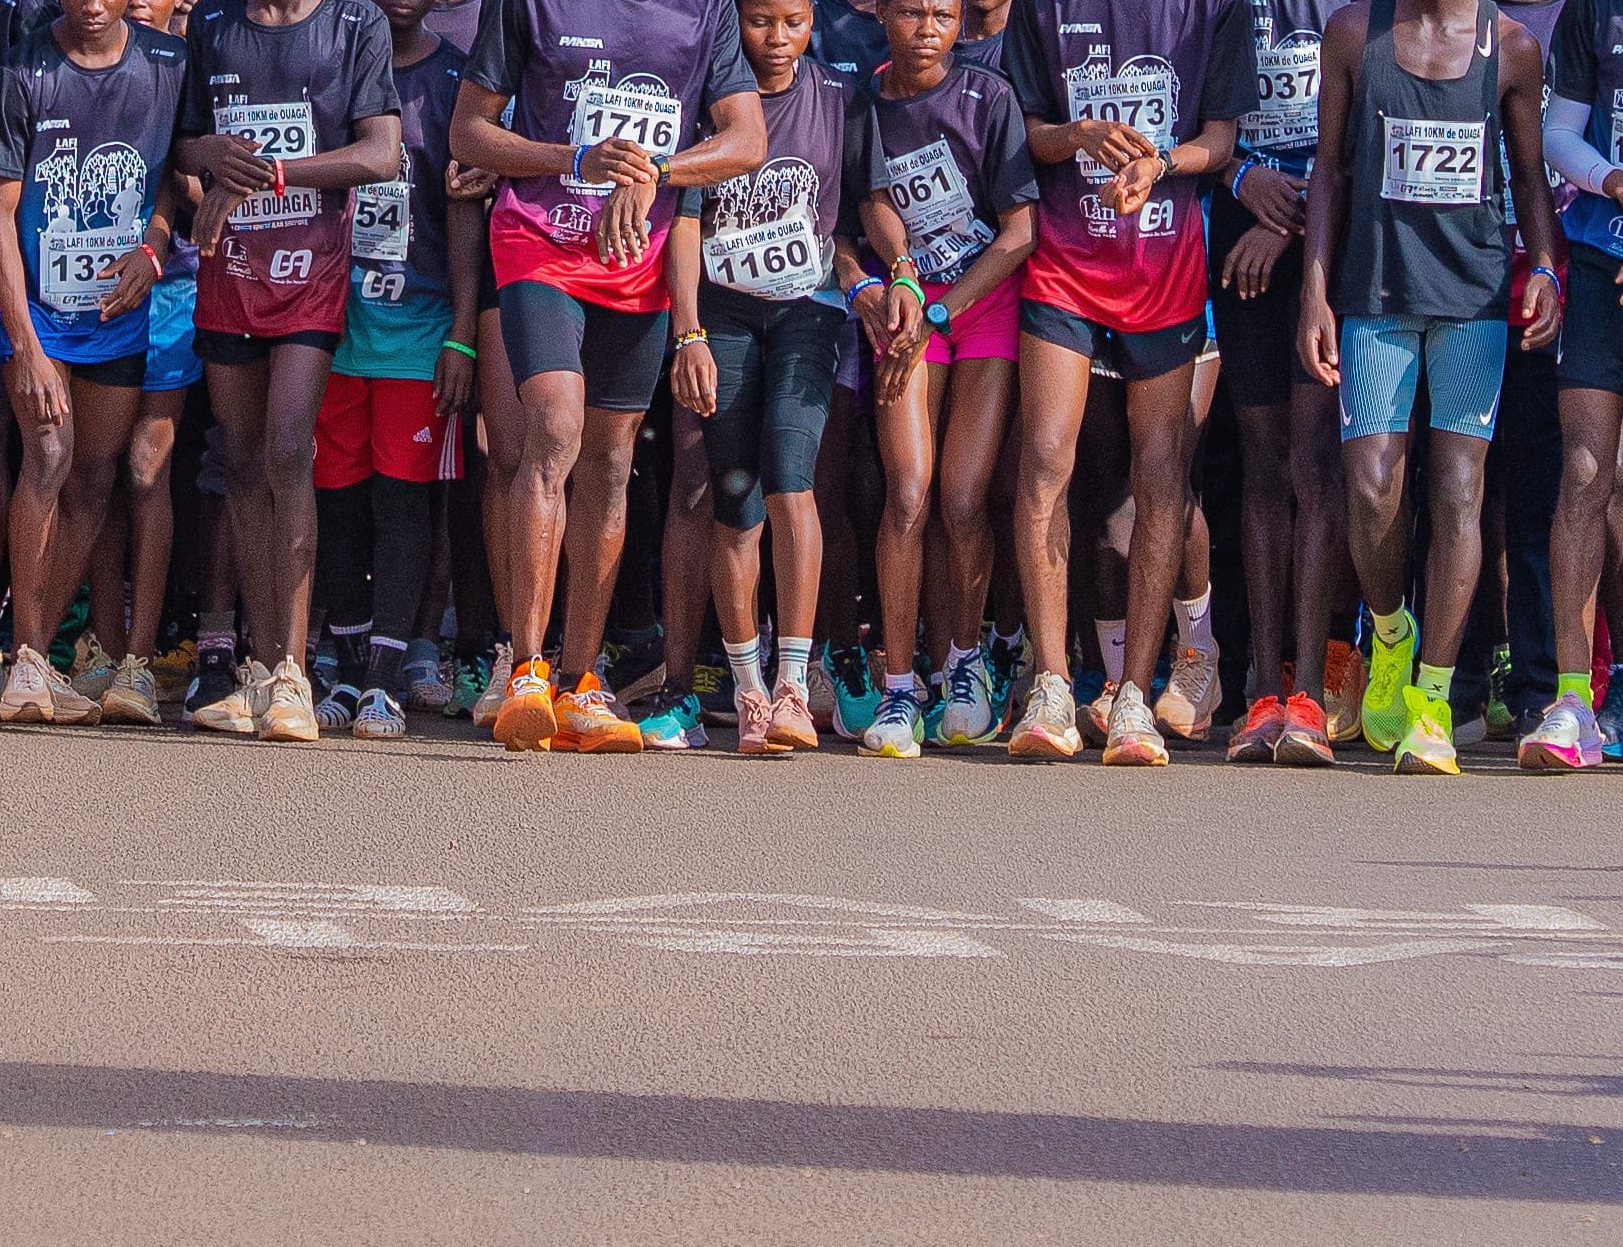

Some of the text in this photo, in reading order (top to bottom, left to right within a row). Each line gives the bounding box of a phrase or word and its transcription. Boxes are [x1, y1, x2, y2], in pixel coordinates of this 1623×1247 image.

[1254, 16, 1273, 28] LAFI
[1089, 44, 1110, 55] LAFI
[590, 59, 610, 70] LAFI
[1261, 55, 1280, 67] 10KM
[1282, 54, 1291, 65] de
[1091, 81, 1166, 97] LAFI 10KM de OUAGA
[1258, 69, 1317, 100] 037
[229, 94, 248, 104] LAFI
[605, 94, 676, 114] LAFI 10KM de OUAGA
[230, 108, 307, 122] LAFI 10KM de OUAGA
[1079, 99, 1165, 127] 1073
[586, 108, 674, 147] 1716
[1405, 125, 1422, 137] LAFI
[1424, 127, 1445, 138] 10KM
[1447, 127, 1456, 138] de
[56, 138, 77, 147] LAFI
[890, 150, 945, 178] 10KM de OUAGA
[1392, 143, 1477, 173] 1722
[368, 184, 404, 198] de OUAGA
[892, 166, 952, 209] 061
[242, 193, 313, 217] DE OUAGA
[356, 204, 400, 231] 54
[67, 234, 139, 248] LAFI 10KM de OUAGA
[726, 221, 805, 251] LAFI 10KM de OUAGA
[52, 254, 118, 282] 132
[717, 240, 809, 284] 1160
